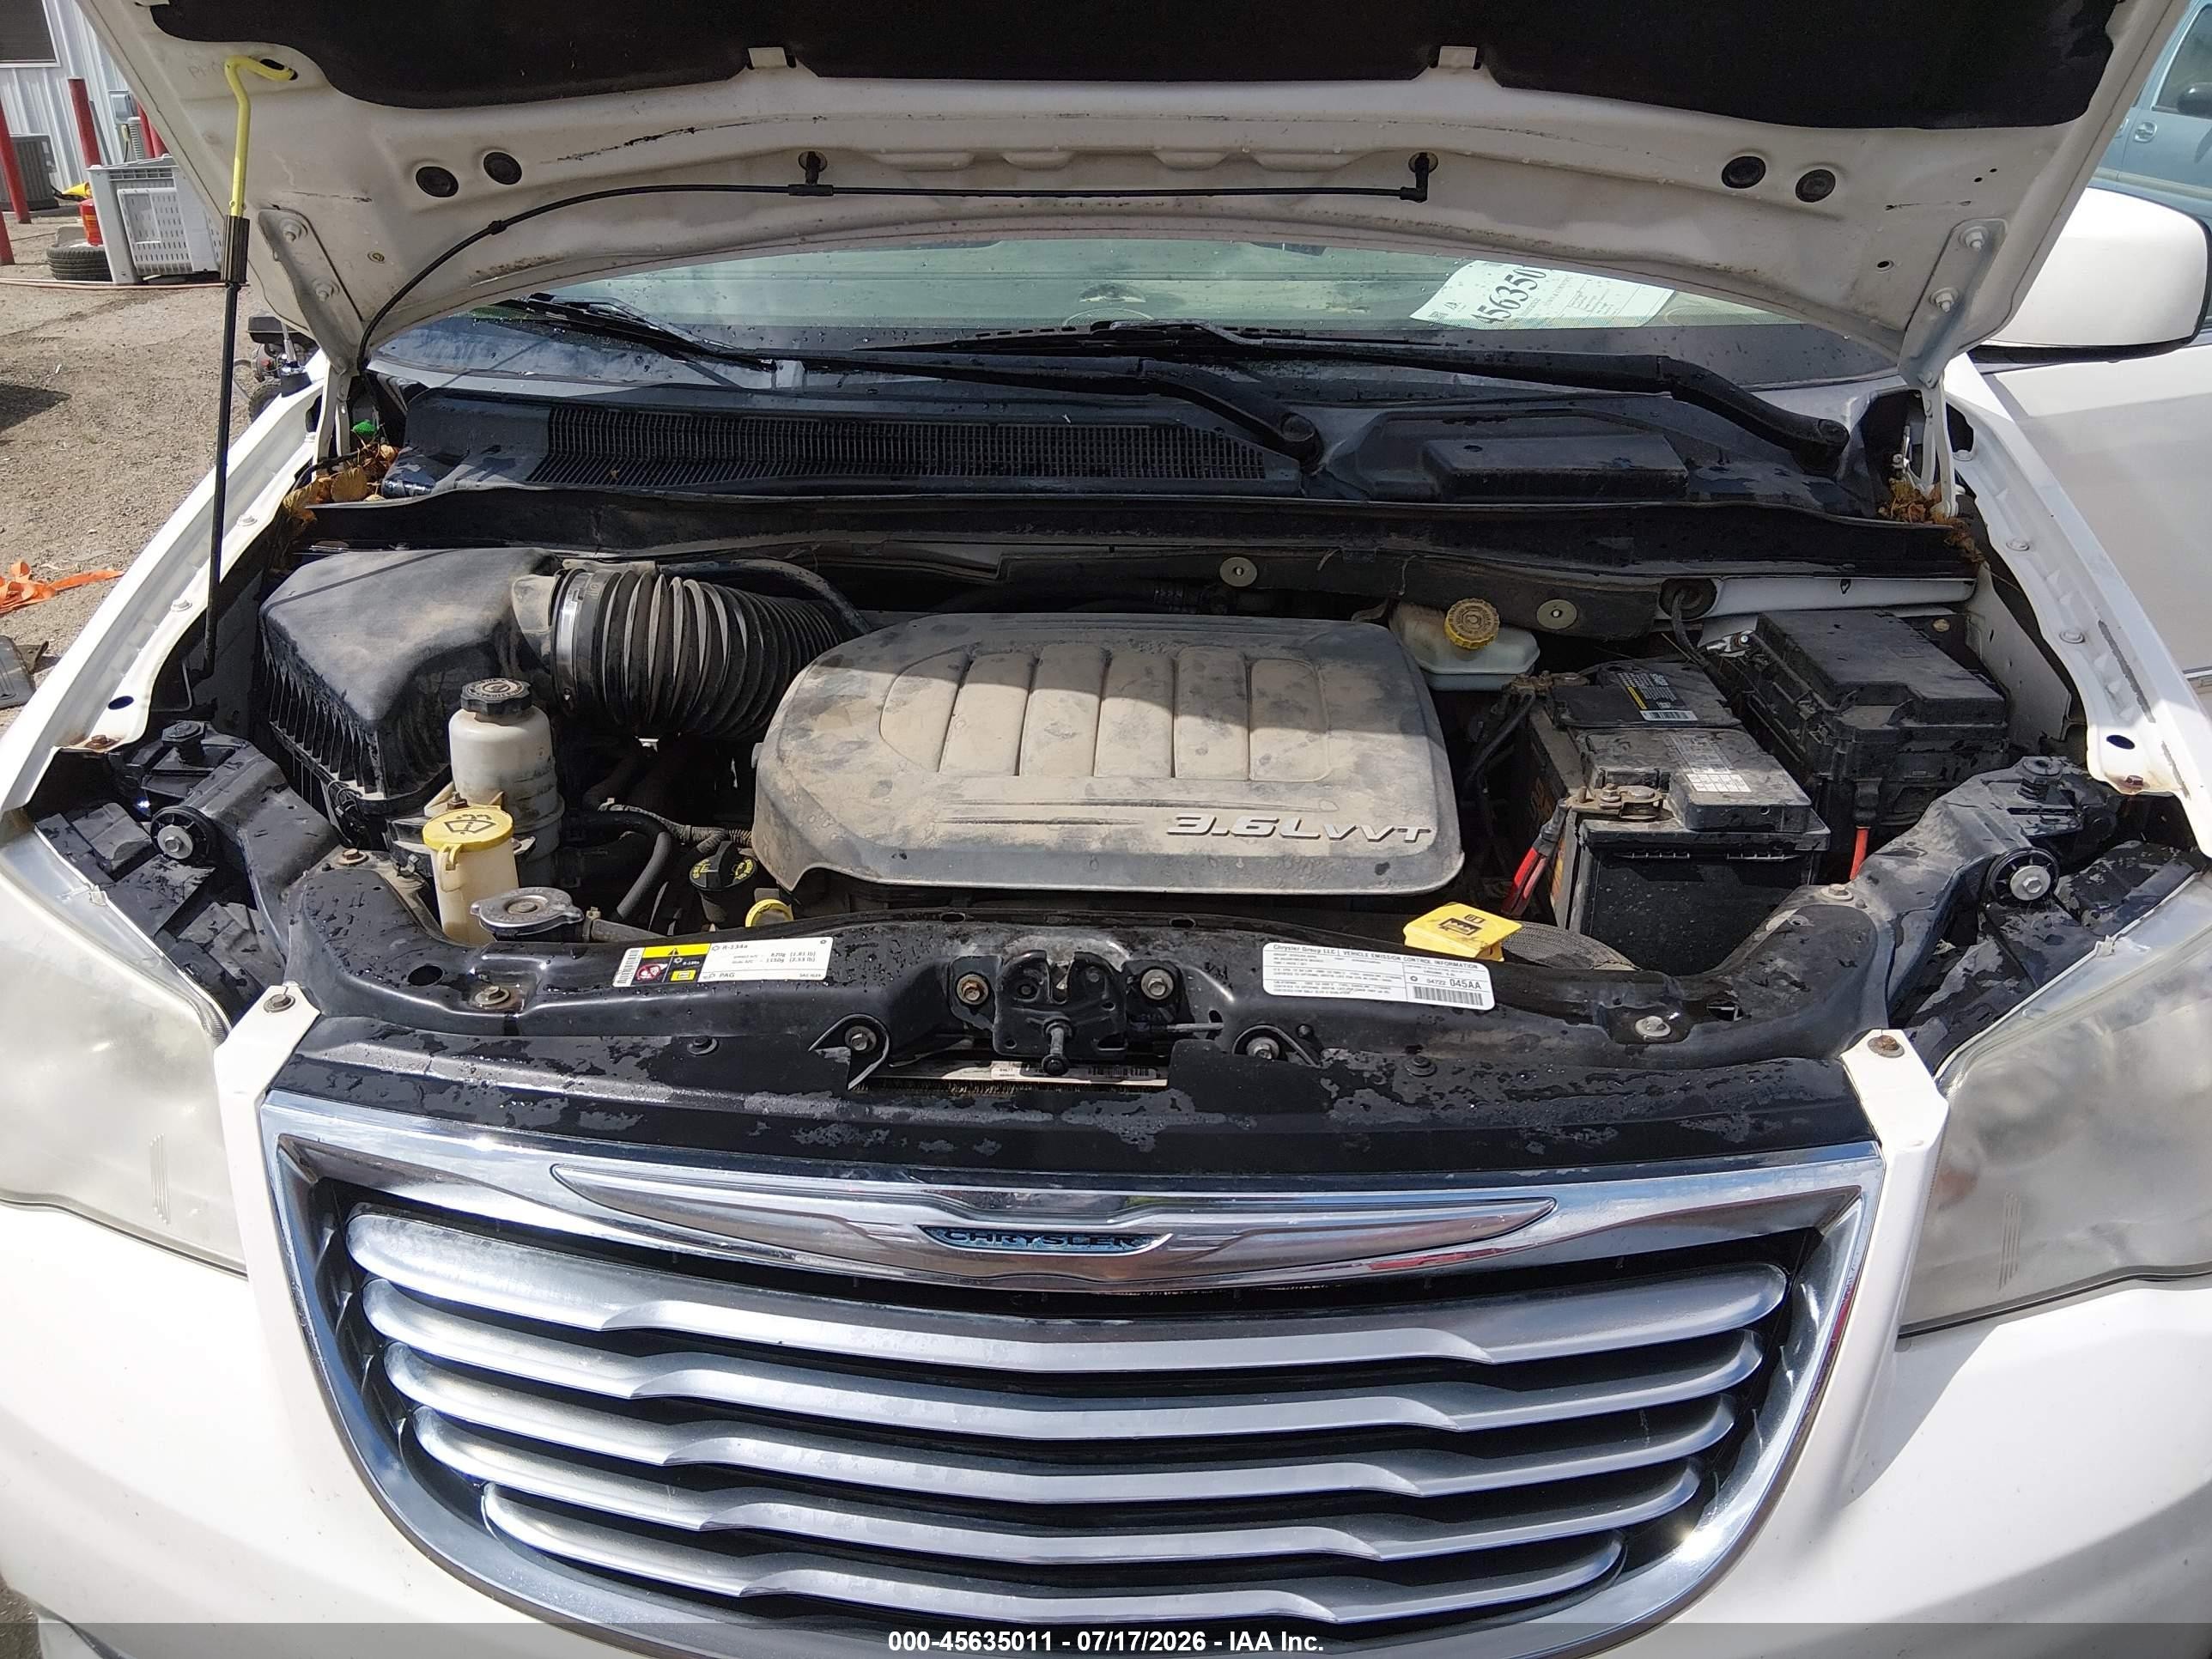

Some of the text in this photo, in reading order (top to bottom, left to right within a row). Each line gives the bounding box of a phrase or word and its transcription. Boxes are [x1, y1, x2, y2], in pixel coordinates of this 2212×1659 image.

[1273, 944, 1301, 952] Chrysler
[1302, 946, 1322, 955] Group
[1343, 950, 1369, 958] VEHICLE
[1370, 953, 1401, 962] EMISSION
[1403, 956, 1433, 965] CONTROL
[1434, 959, 1479, 970] INFORMATION
[945, 1230, 1134, 1247] CHRYSLER
